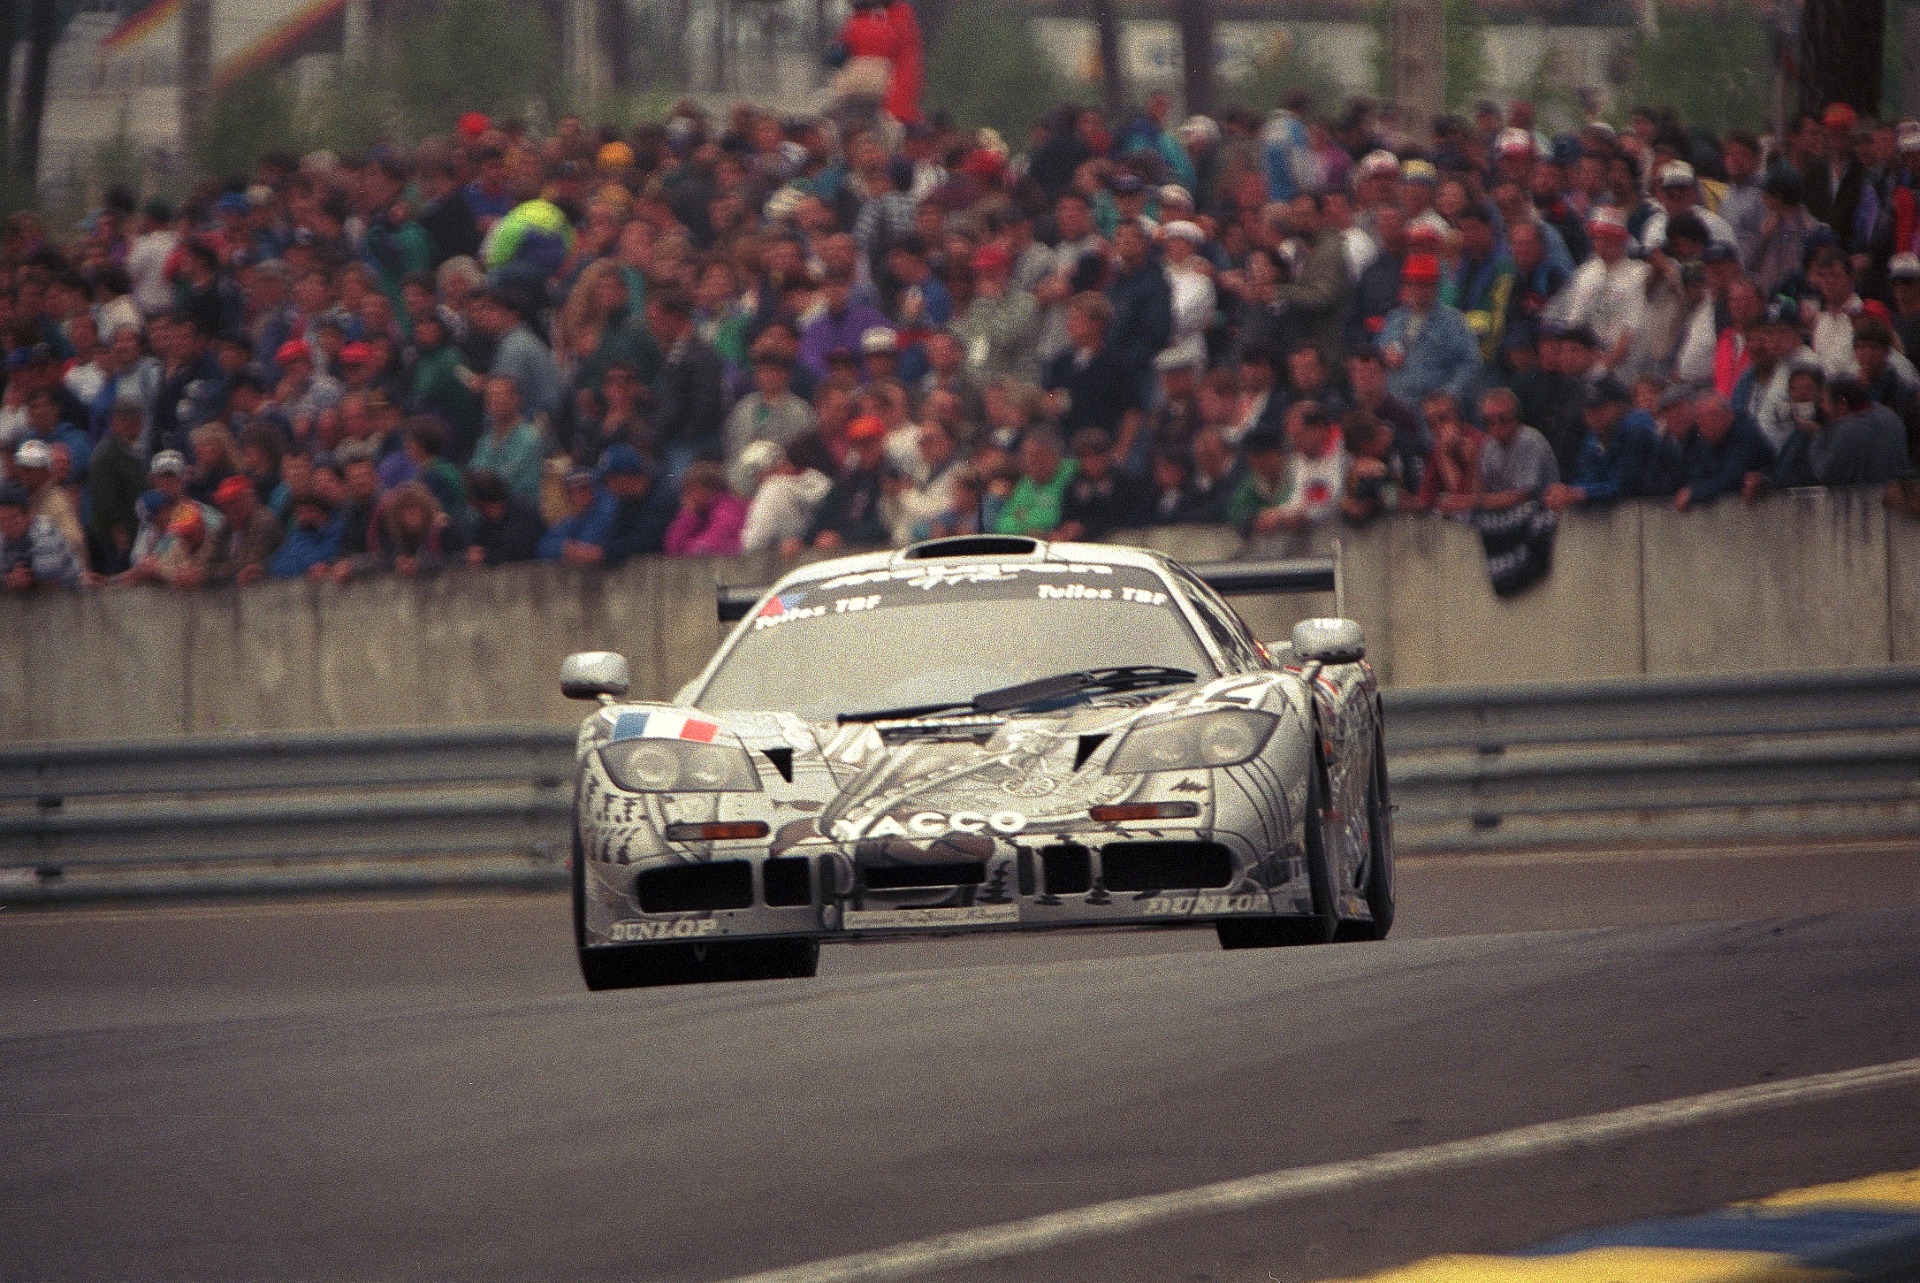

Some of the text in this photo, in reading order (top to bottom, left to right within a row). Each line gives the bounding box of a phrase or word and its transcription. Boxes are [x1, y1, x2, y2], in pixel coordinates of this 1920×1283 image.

[830, 811, 1027, 839] YACCO
[1142, 893, 1269, 916] DUNLOP
[608, 918, 717, 941] DUNLOP
